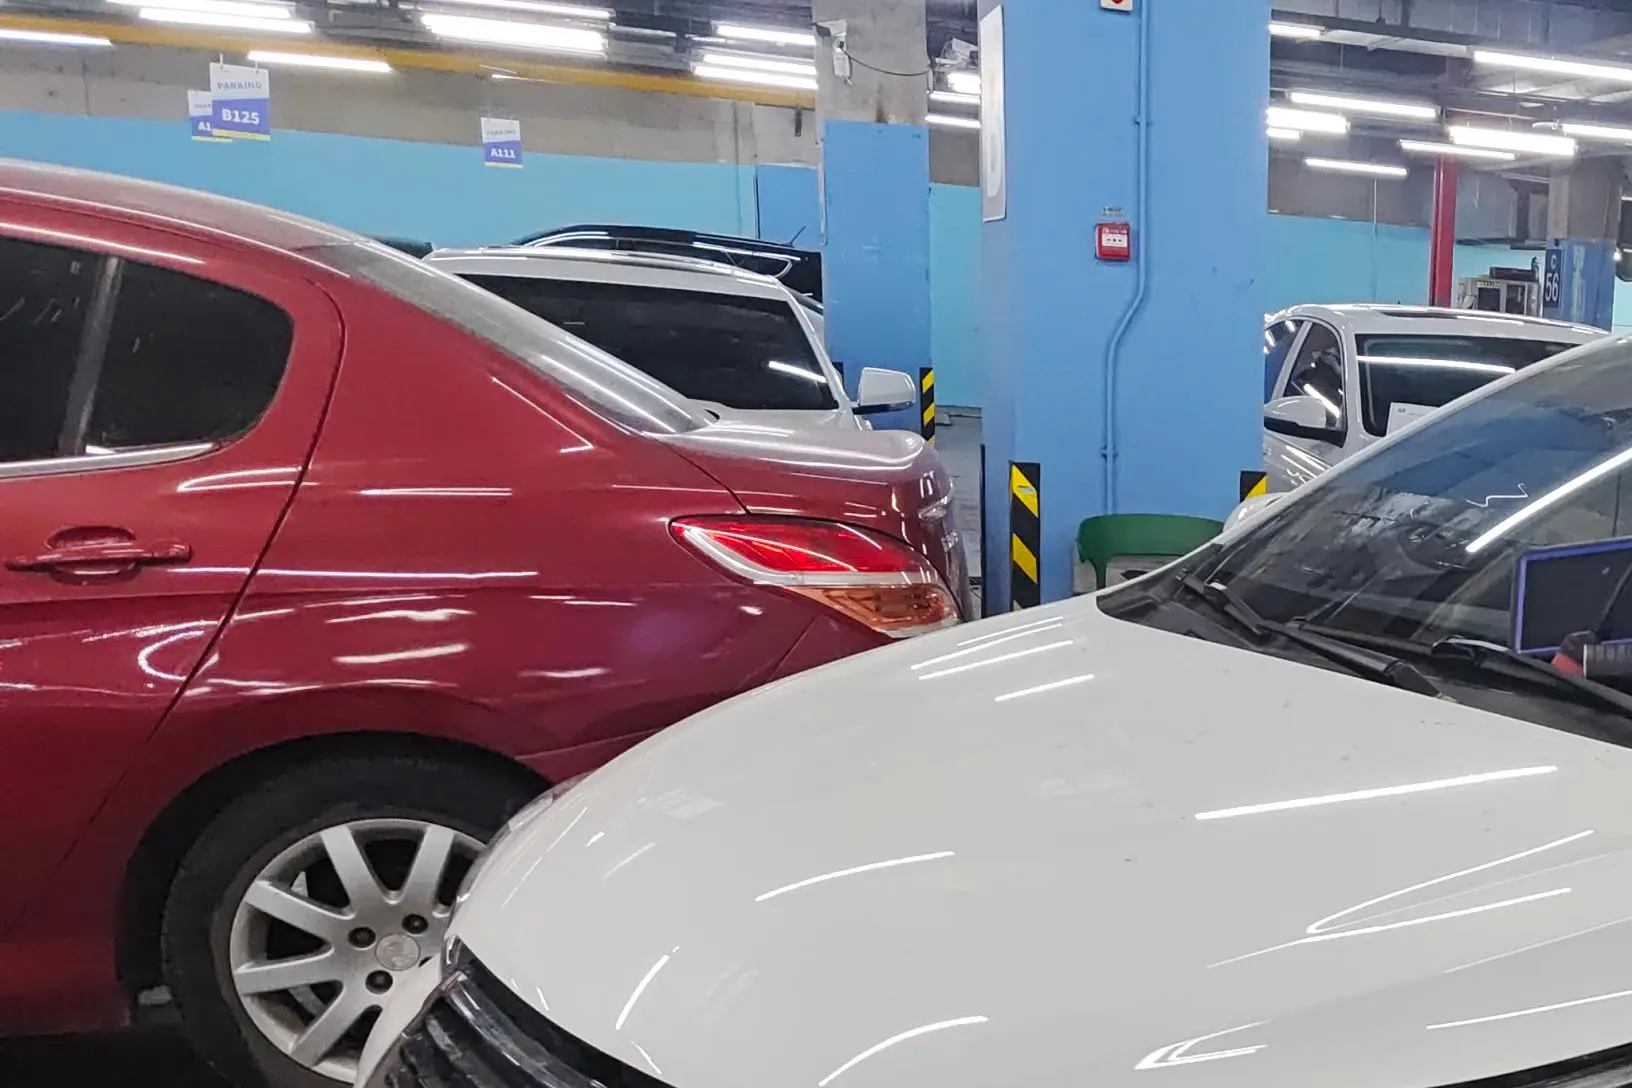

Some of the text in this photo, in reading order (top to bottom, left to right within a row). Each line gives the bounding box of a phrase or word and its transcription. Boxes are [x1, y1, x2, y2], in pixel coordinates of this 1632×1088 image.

[217, 81, 262, 90] PARKING
[222, 108, 260, 125] B125
[490, 147, 517, 159] A111
[1550, 253, 1557, 269] C
[1544, 272, 1559, 301] 56
